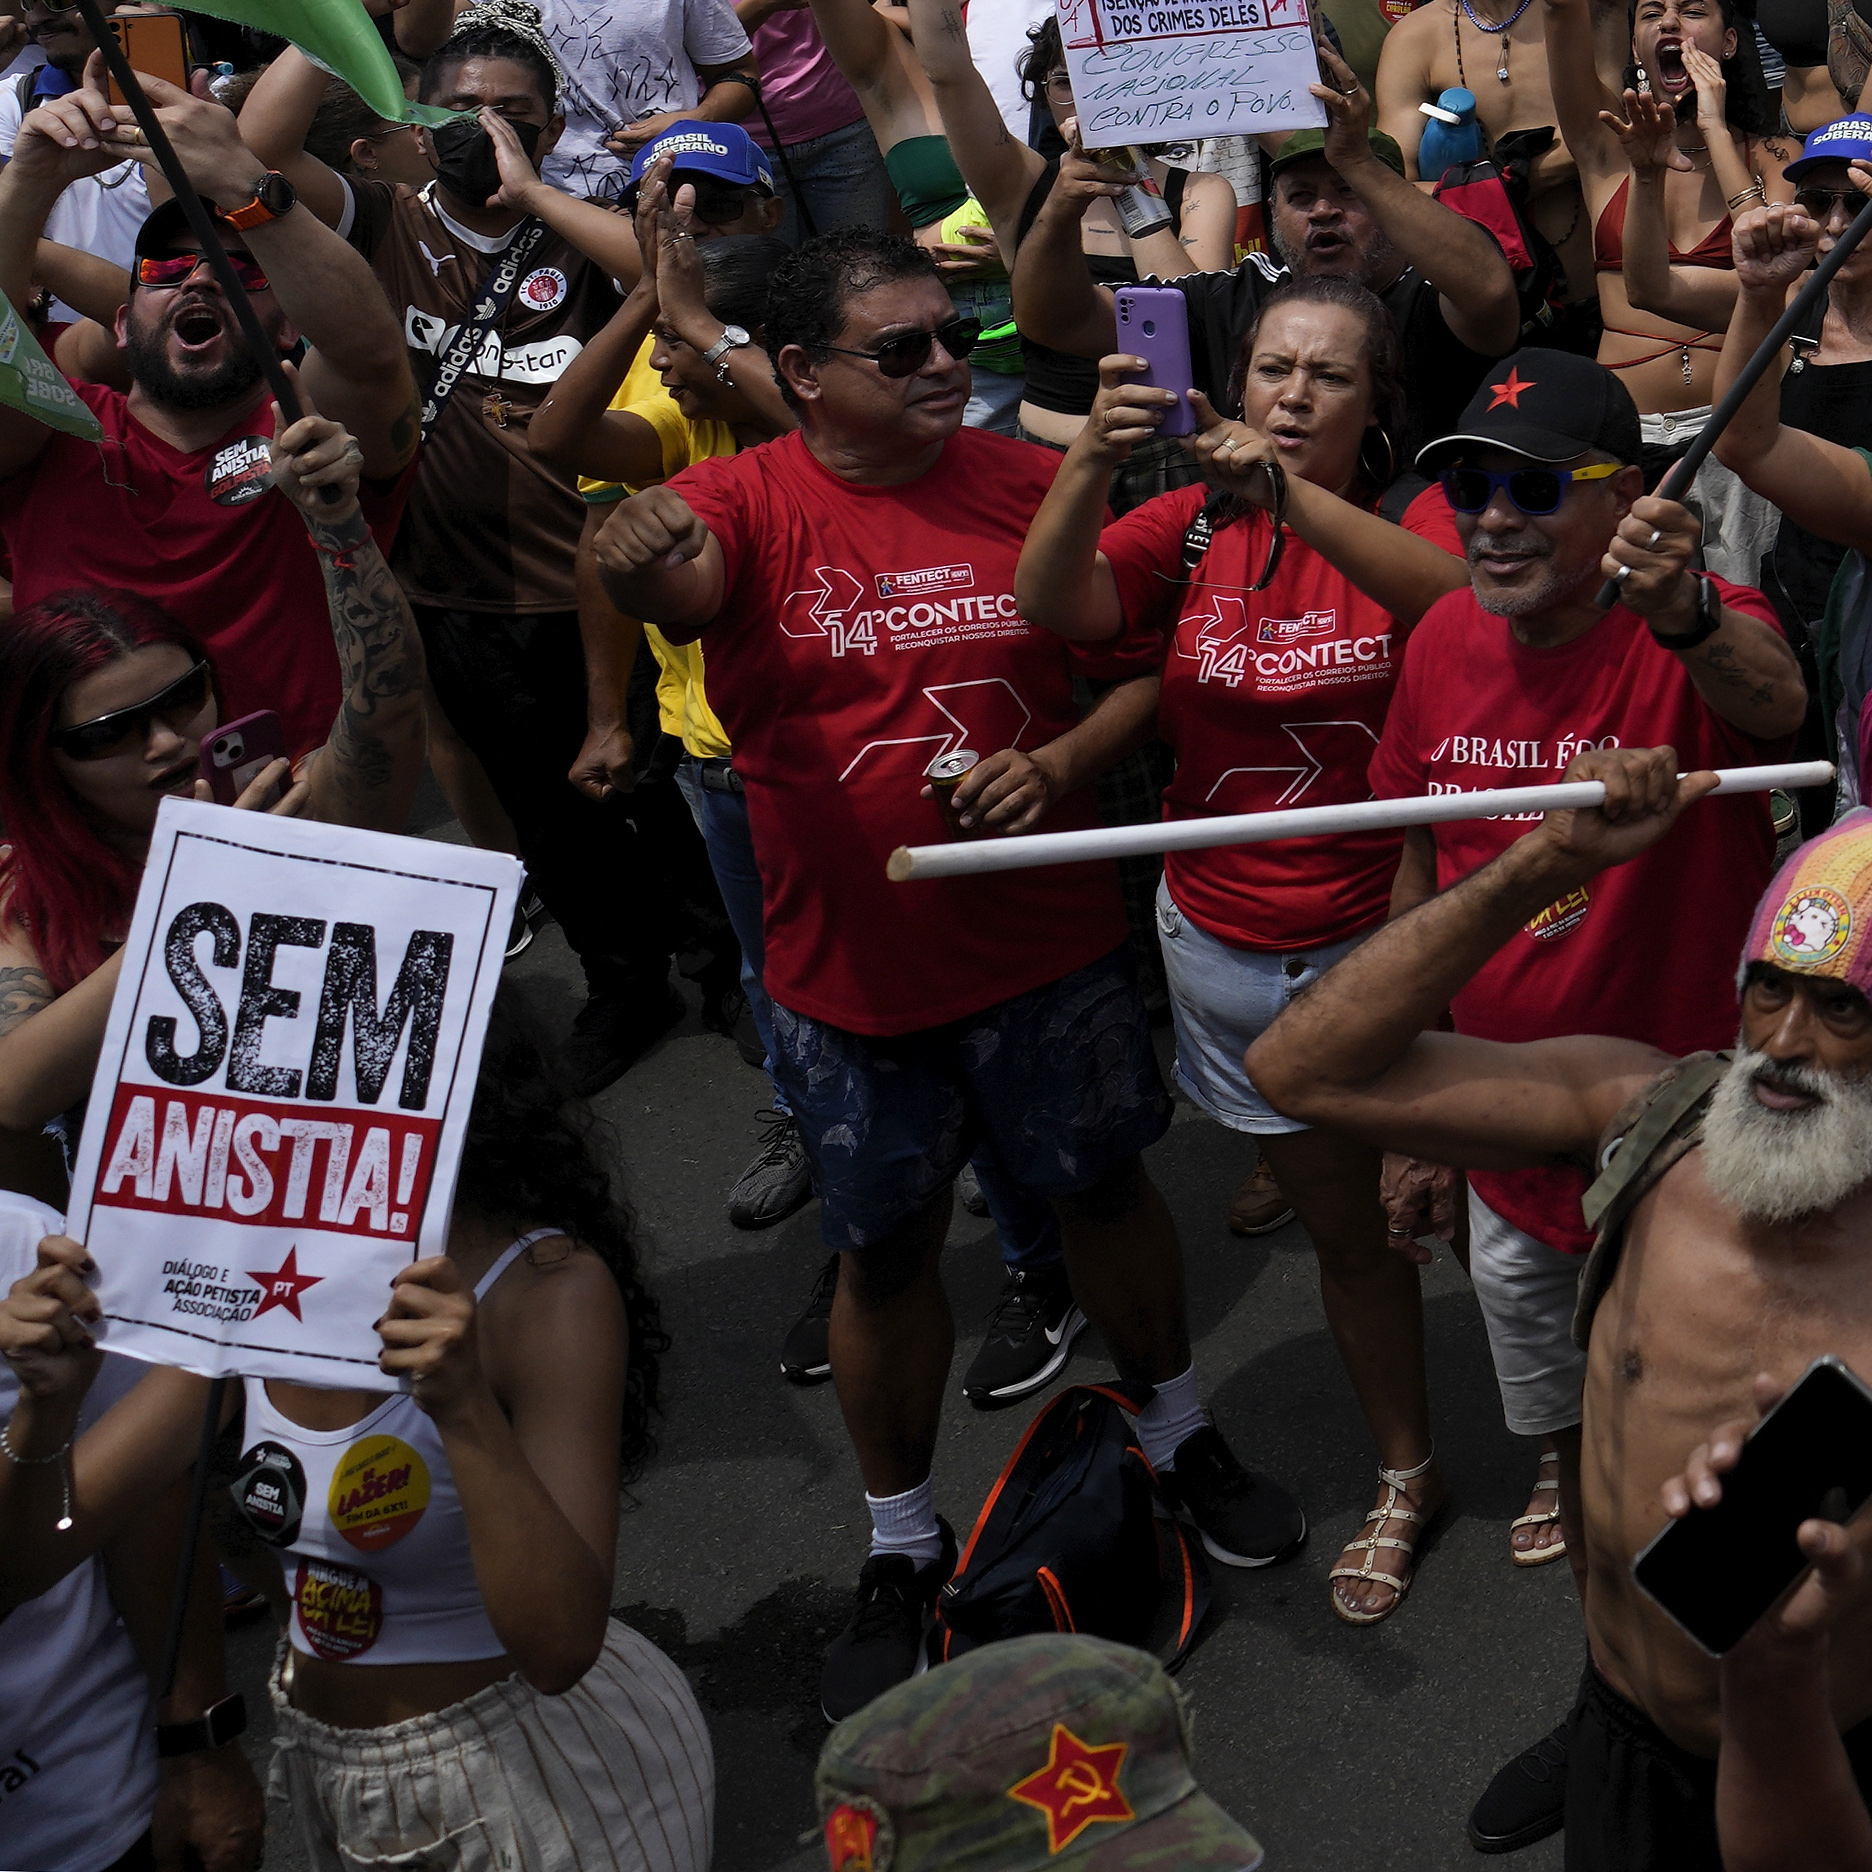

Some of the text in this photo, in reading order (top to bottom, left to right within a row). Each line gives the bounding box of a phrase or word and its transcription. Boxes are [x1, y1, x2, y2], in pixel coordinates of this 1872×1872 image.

[1112, 5, 1260, 37] DOS CRIMES DELES
[1082, 30, 1311, 75] CONGRESSO
[1082, 64, 1269, 100] NACIONAL
[1088, 95, 1194, 132] CONTRA
[1206, 99, 1219, 116] O
[653, 133, 714, 153] BRASIL
[539, 300, 559, 310] 1910
[433, 328, 481, 396] adidas
[212, 445, 272, 482] ANISTIA
[216, 440, 249, 466] SEM
[895, 569, 950, 586] FENTECT
[885, 594, 1018, 631] CONTEC
[890, 621, 1000, 644] FORTALECER OS CORREIOS
[895, 635, 961, 652] RECONQUISTAR
[961, 629, 996, 641] NOSSOS
[1255, 633, 1393, 676] CONTECT
[1255, 666, 1353, 687] FORTALECER OS CORREIOS
[1256, 681, 1316, 693] RECONQUISTAR
[1316, 675, 1352, 686] NOSSOS
[1450, 735, 1549, 769] BRASIL
[1554, 731, 1576, 770] É
[145, 901, 456, 1112] SEM
[101, 1095, 427, 1236] ANISTIA!
[162, 1257, 230, 1282] DIÁLOGO E
[163, 1277, 262, 1305] AÇÃO PETISTA
[271, 1281, 295, 1298] PT
[173, 1297, 253, 1325] ASSOCIAÇÃO
[246, 1494, 285, 1517] ANISTIA
[255, 1482, 280, 1502] SEM
[303, 1576, 372, 1614] ACIMA
